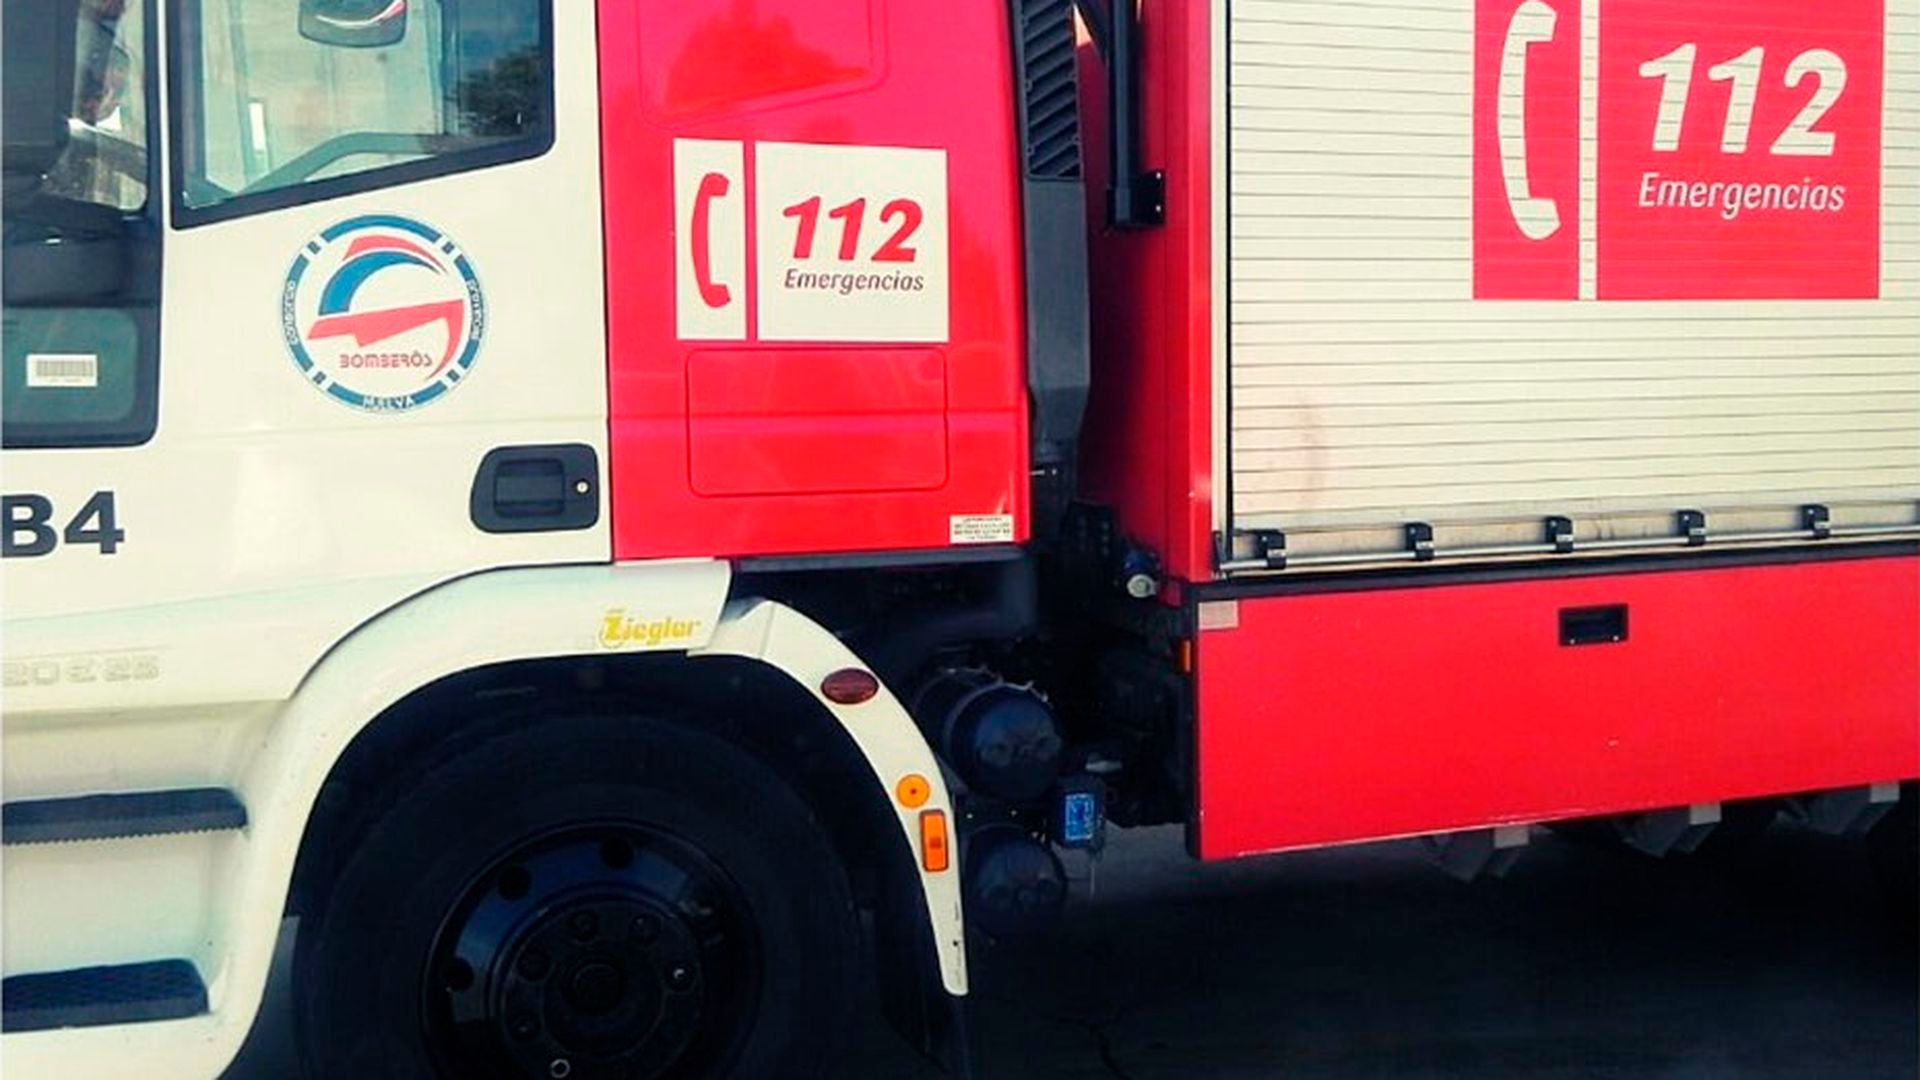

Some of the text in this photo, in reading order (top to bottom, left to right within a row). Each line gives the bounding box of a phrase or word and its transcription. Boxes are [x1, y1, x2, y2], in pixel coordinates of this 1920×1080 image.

[1639, 43, 1847, 155] 112
[783, 196, 923, 262] 112
[1638, 172, 1845, 220] Emergencias
[784, 268, 924, 295] Emergencias
[0, 491, 125, 558] B4
